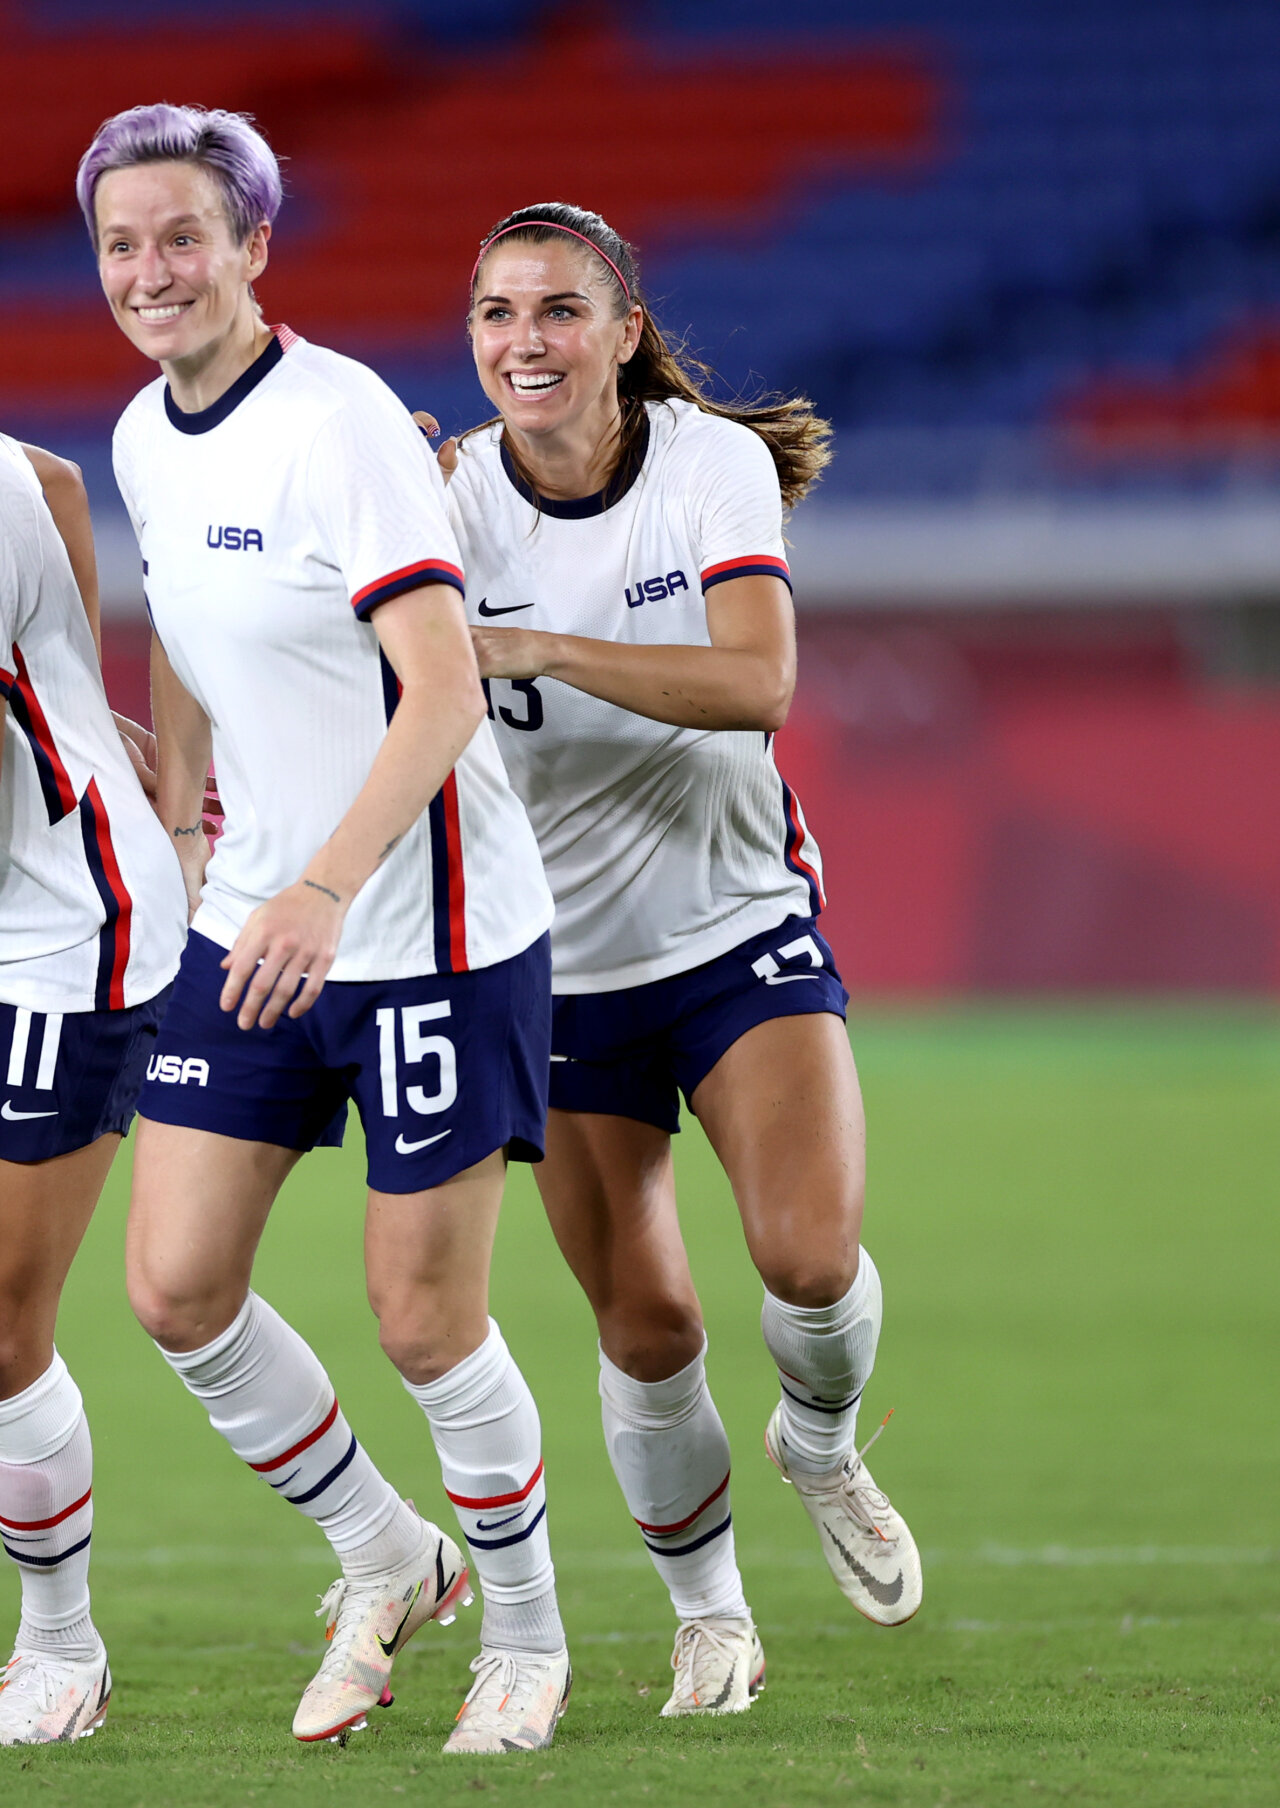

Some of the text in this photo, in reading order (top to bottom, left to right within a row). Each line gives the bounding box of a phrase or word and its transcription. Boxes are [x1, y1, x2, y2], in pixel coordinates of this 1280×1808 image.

[207, 525, 263, 552] USA
[624, 570, 689, 609] USA
[6, 1006, 64, 1091] 11
[376, 999, 458, 1118] 15
[146, 1054, 210, 1087] USA
